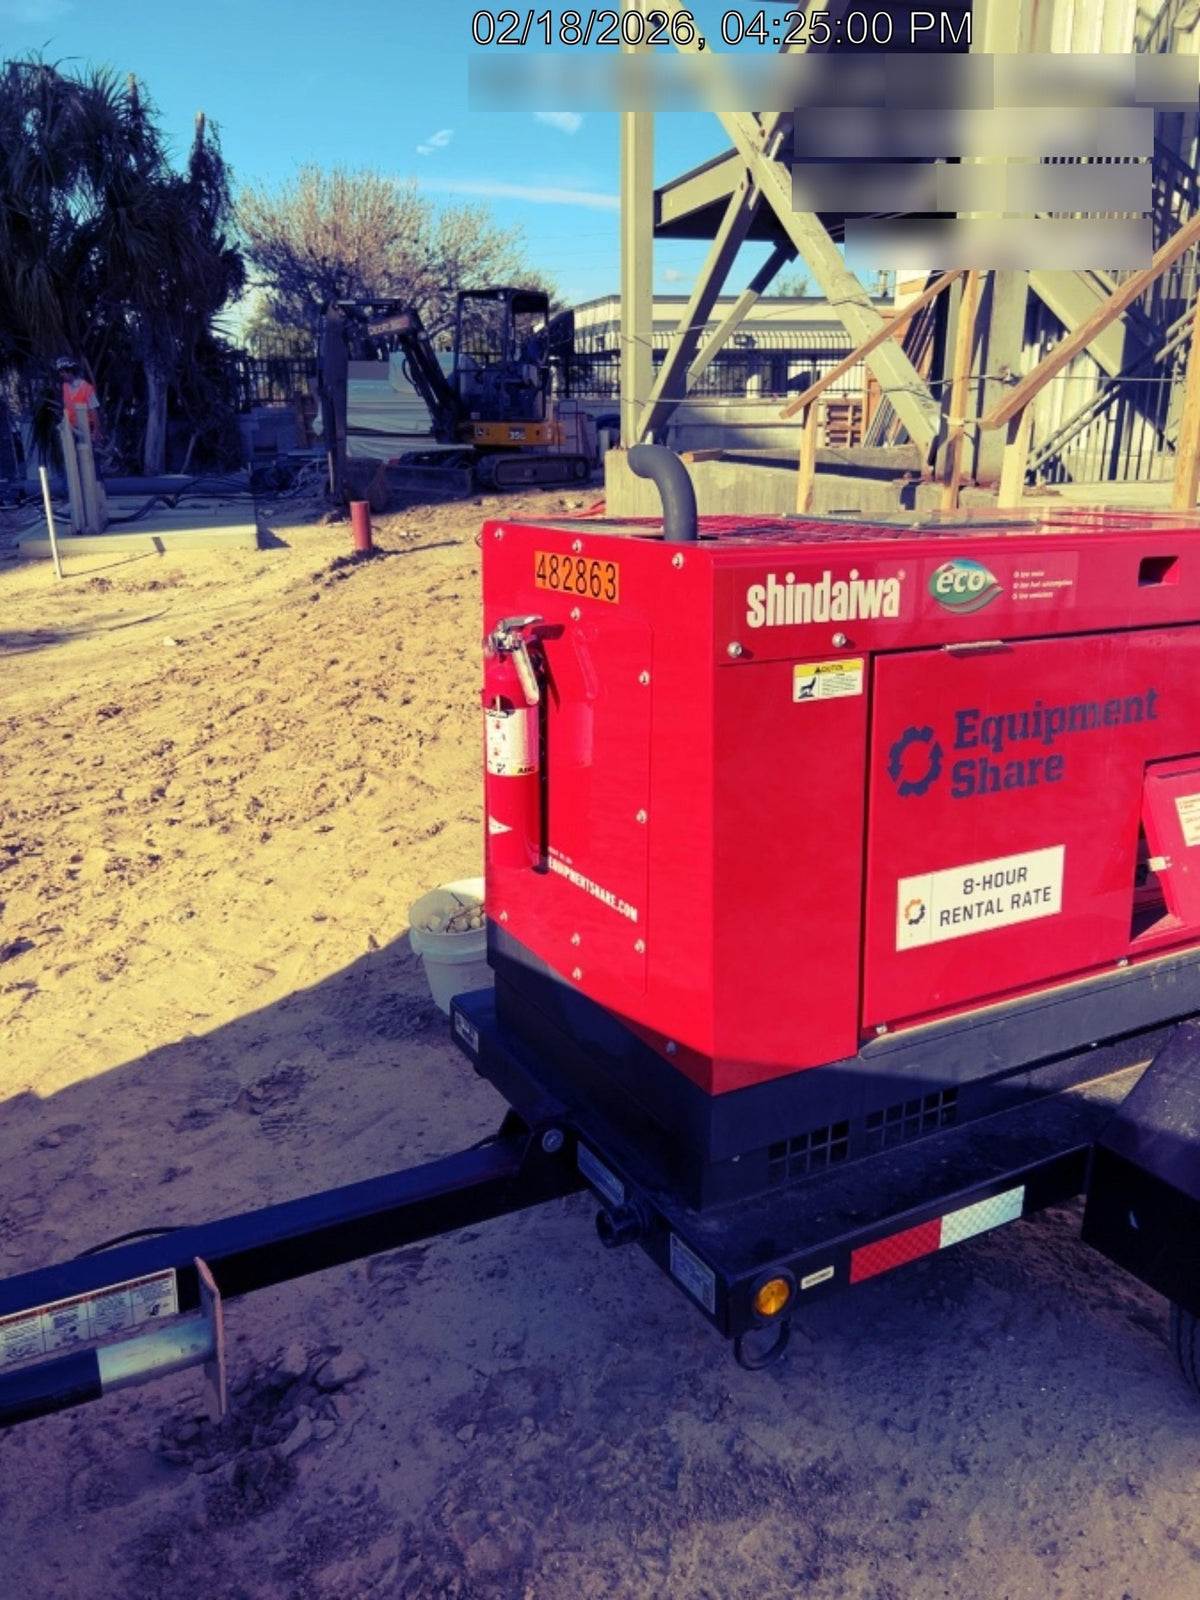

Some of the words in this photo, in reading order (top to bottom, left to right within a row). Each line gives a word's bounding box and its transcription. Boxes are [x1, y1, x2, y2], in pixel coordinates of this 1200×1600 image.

[536, 553, 617, 601] 482863
[746, 568, 900, 629] shindaiwa
[954, 687, 1160, 753] Equipment
[951, 753, 1065, 799] Share
[963, 866, 1028, 895] 8-HOUR
[940, 897, 1004, 927] RENTAL
[1011, 886, 1052, 910] RATE
